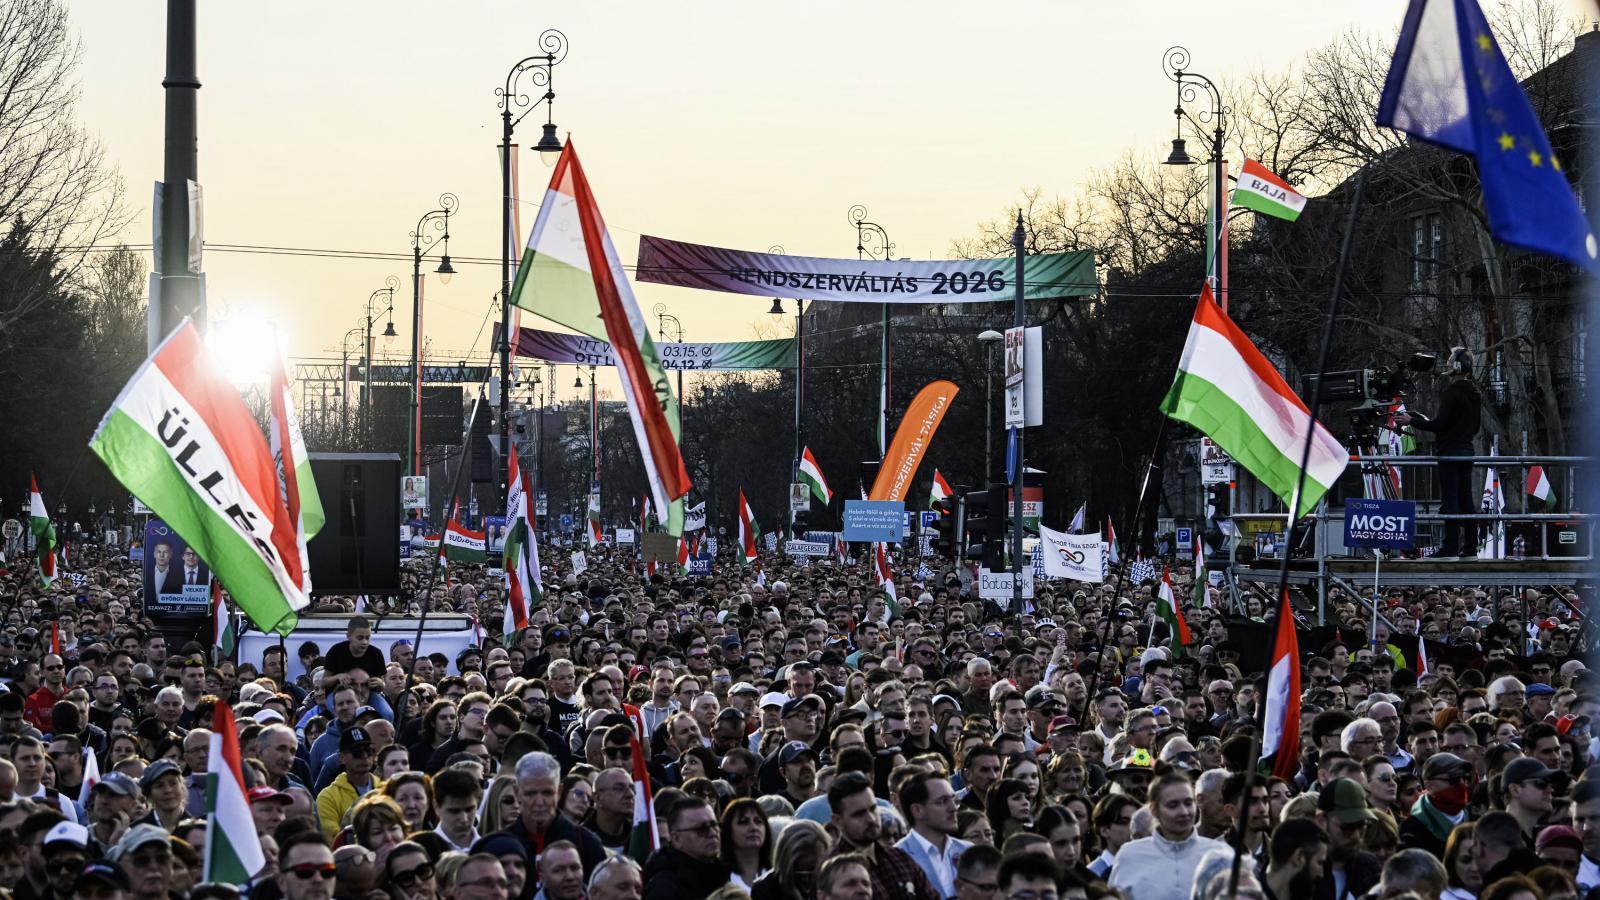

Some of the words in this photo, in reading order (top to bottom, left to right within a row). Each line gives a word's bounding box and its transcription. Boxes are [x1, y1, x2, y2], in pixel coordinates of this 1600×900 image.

[1251, 180, 1287, 202] BAJA
[729, 266, 918, 294] RENDSZERVÁLTÁS
[931, 270, 1006, 295] 2026
[577, 339, 600, 351] ITT
[663, 346, 698, 358] 03.15.
[575, 353, 602, 364] OTT
[662, 359, 699, 370] 04.12.
[1350, 514, 1409, 532] MOST
[1179, 531, 1187, 540] P
[1350, 530, 1375, 540] VAGY
[1377, 532, 1408, 541] SOHA!
[62, 572, 87, 581] TISZA
